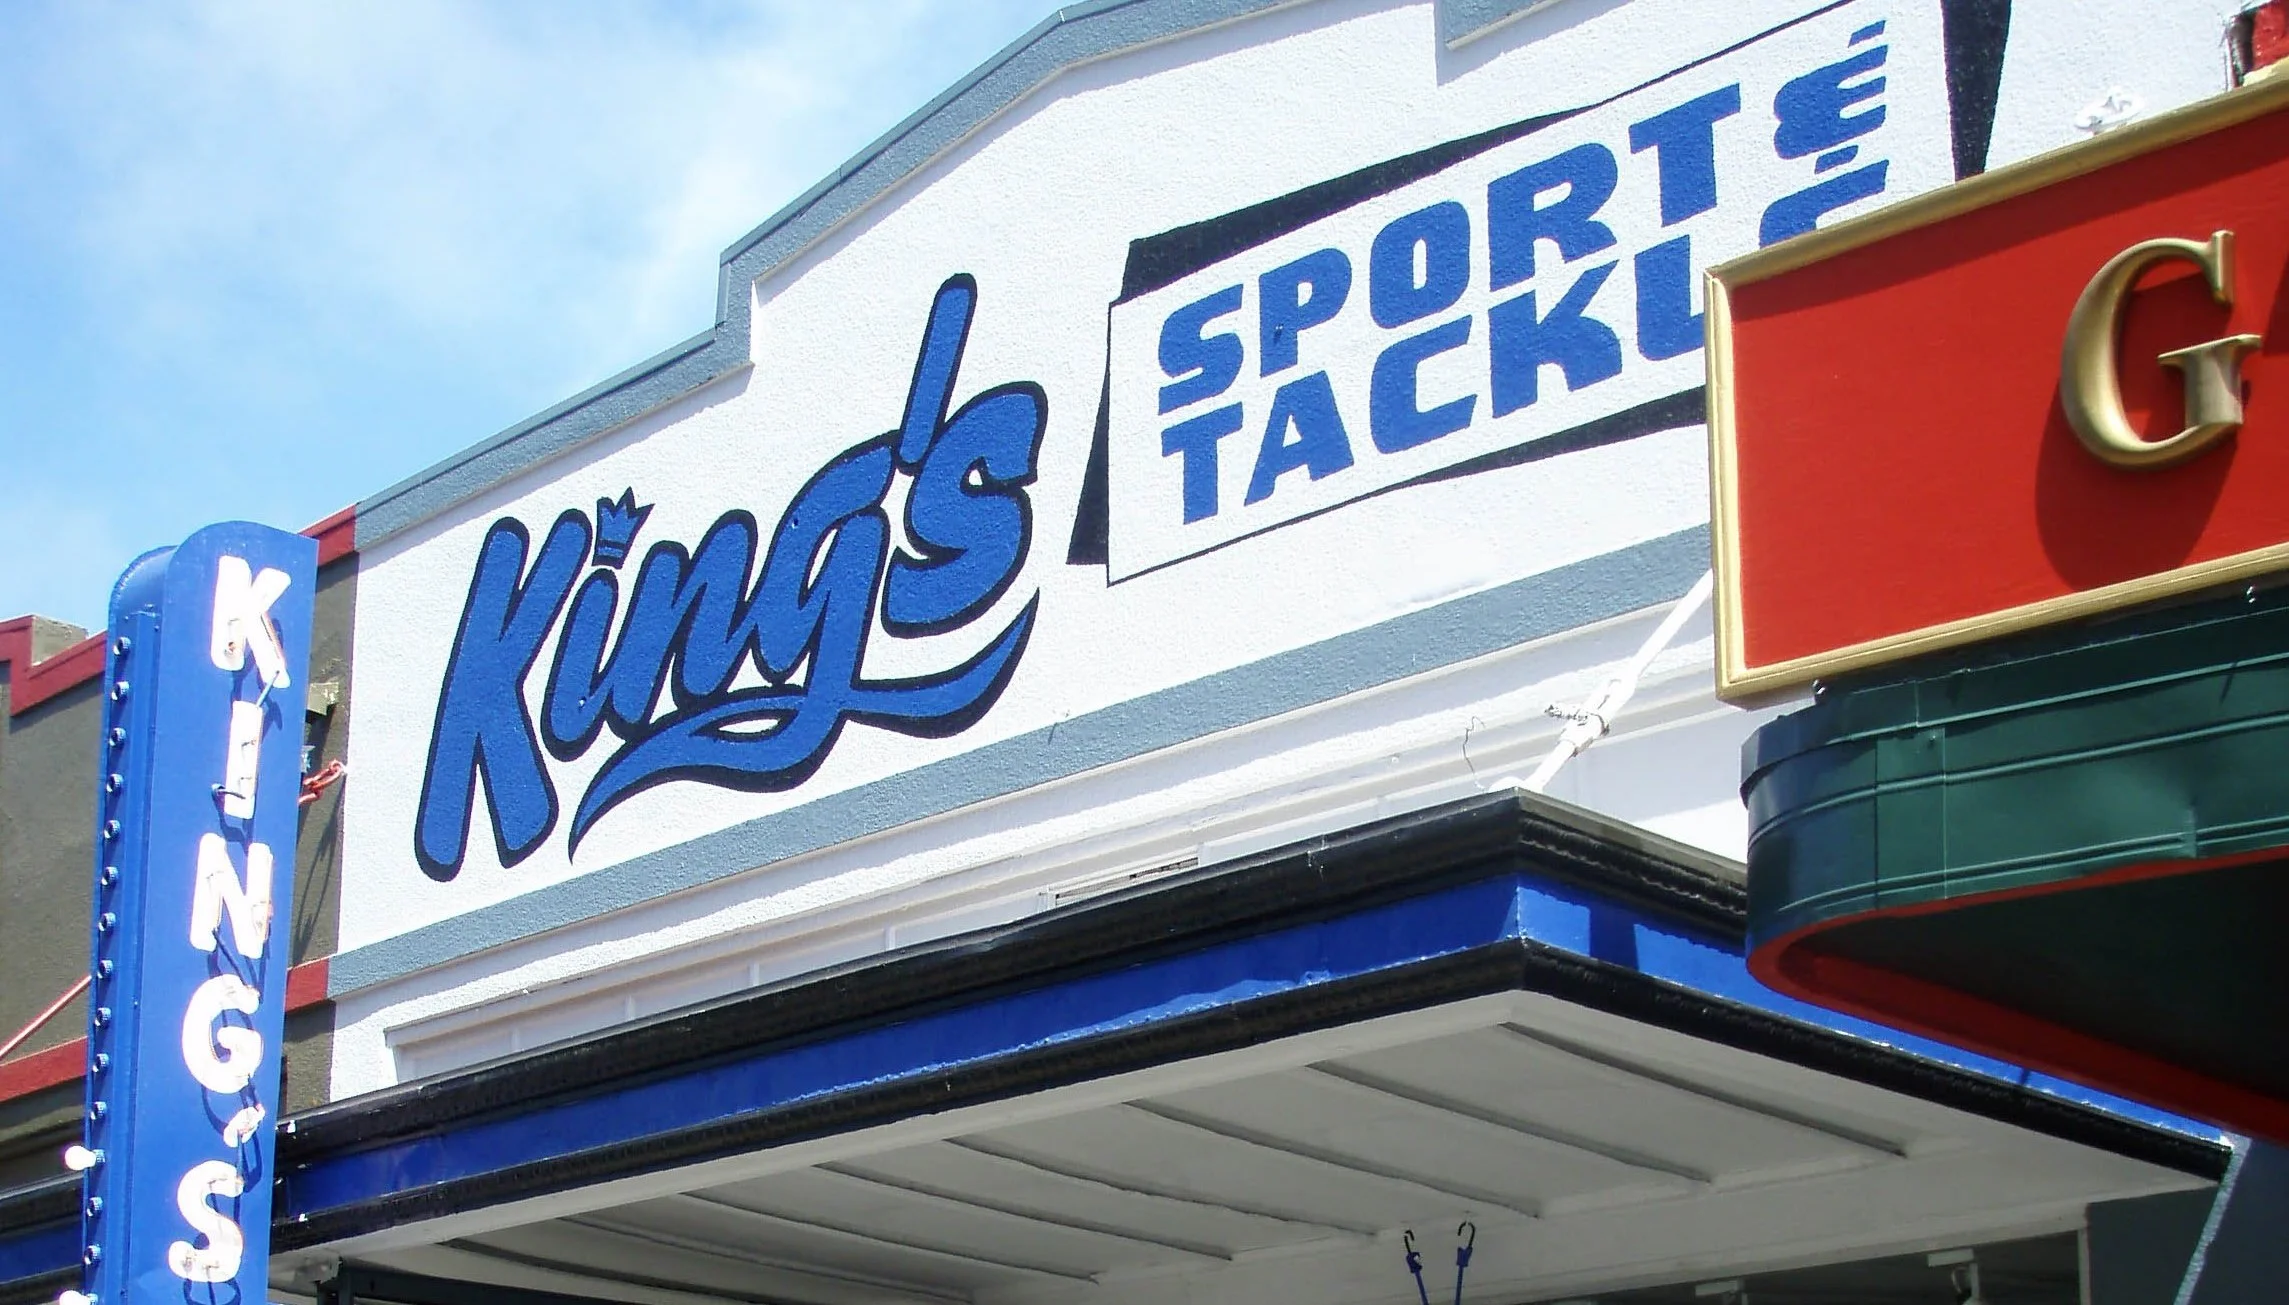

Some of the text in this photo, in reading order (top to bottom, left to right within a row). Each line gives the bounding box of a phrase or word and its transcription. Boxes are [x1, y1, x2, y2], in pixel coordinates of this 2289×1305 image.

[1158, 19, 1889, 415] SPORT &
[415, 273, 1047, 882] King's
[168, 555, 291, 1284] KING'S
